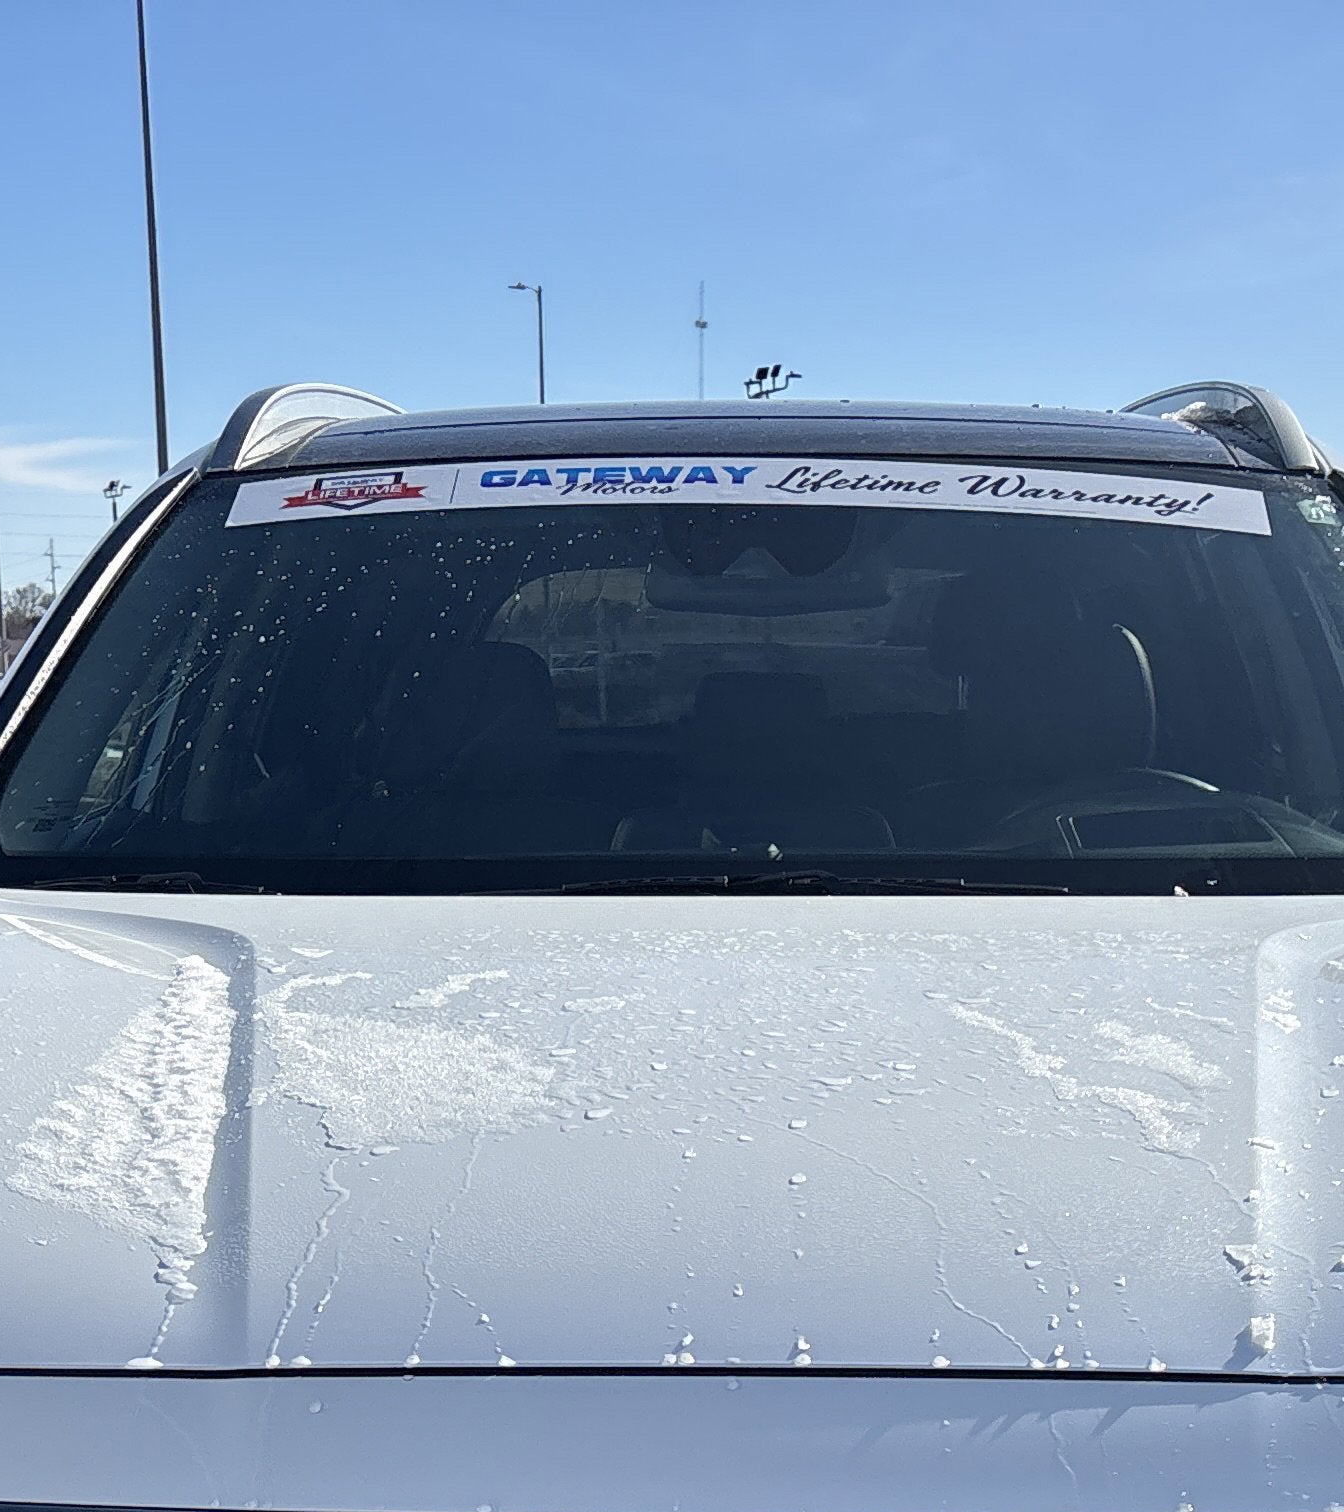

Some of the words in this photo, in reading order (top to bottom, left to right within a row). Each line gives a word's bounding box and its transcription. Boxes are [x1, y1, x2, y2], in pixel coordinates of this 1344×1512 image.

[306, 484, 403, 501] LIFETIME
[480, 466, 758, 488] GATEWAY
[765, 466, 942, 495] Lifetime
[958, 474, 1215, 516] Warranty!
[557, 480, 680, 496] Motors
